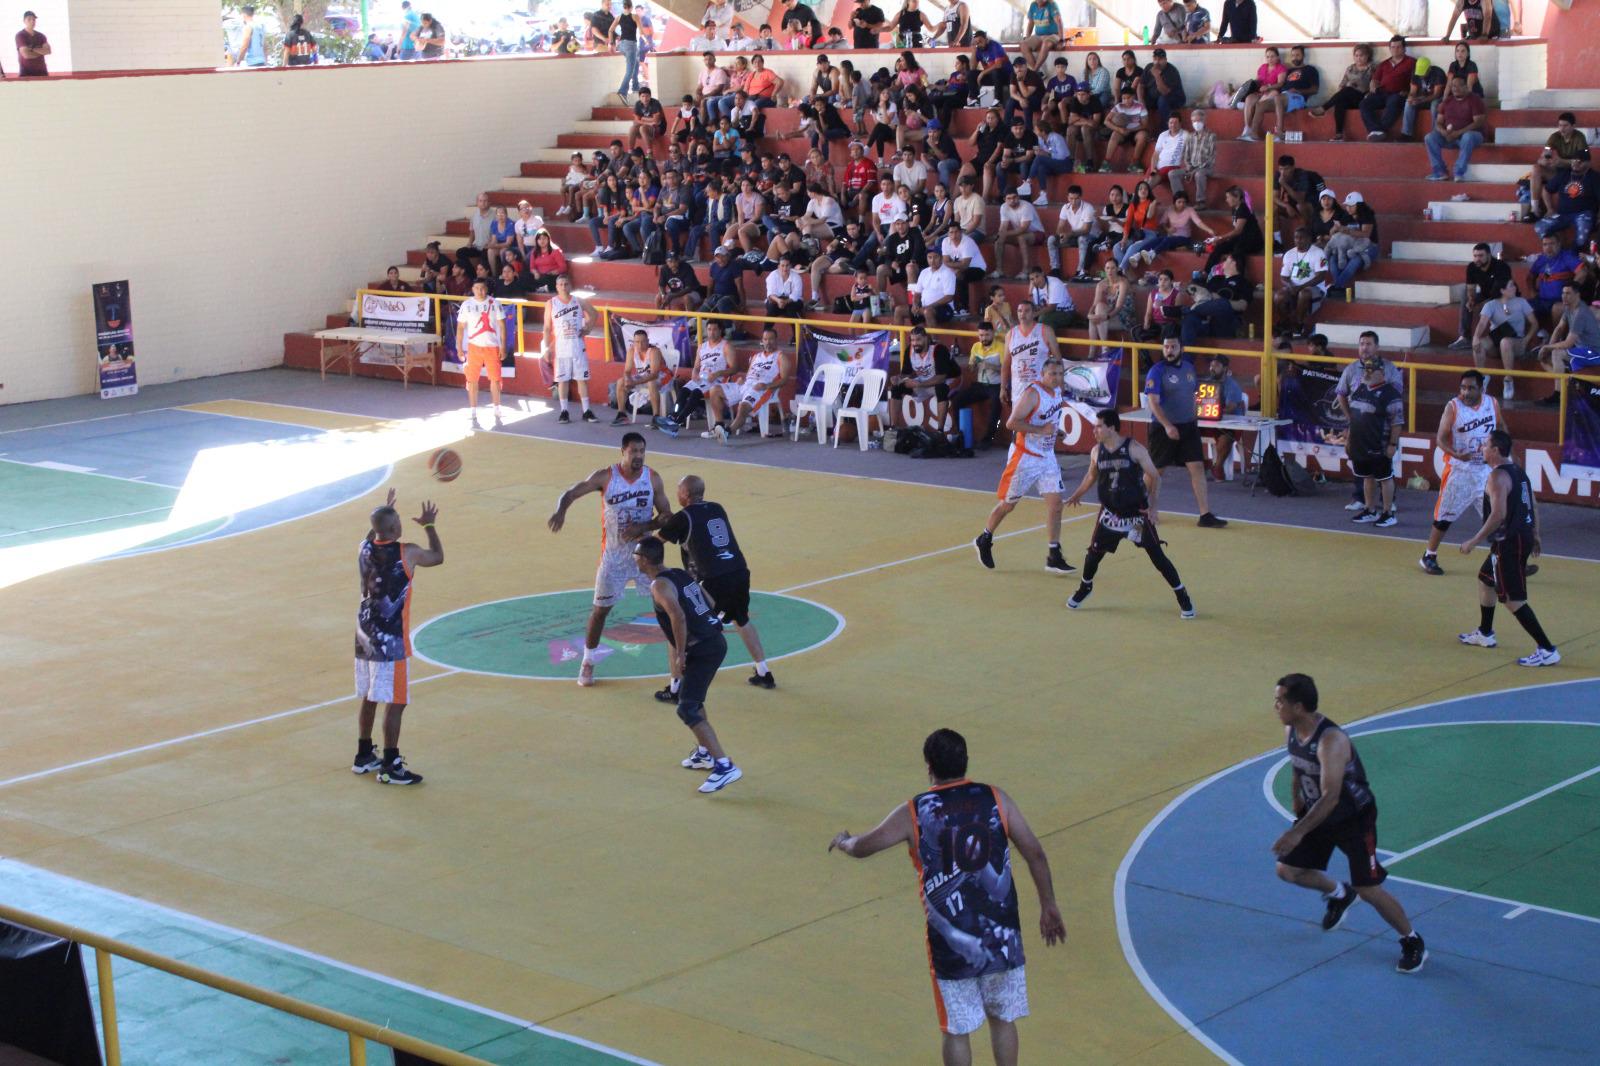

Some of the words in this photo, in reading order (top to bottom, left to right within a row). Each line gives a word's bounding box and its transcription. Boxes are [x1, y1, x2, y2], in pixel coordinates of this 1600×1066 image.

[1199, 384, 1215, 398] 54
[1204, 404, 1219, 416] 36
[707, 518, 729, 547] 9
[946, 890, 963, 917] 17
